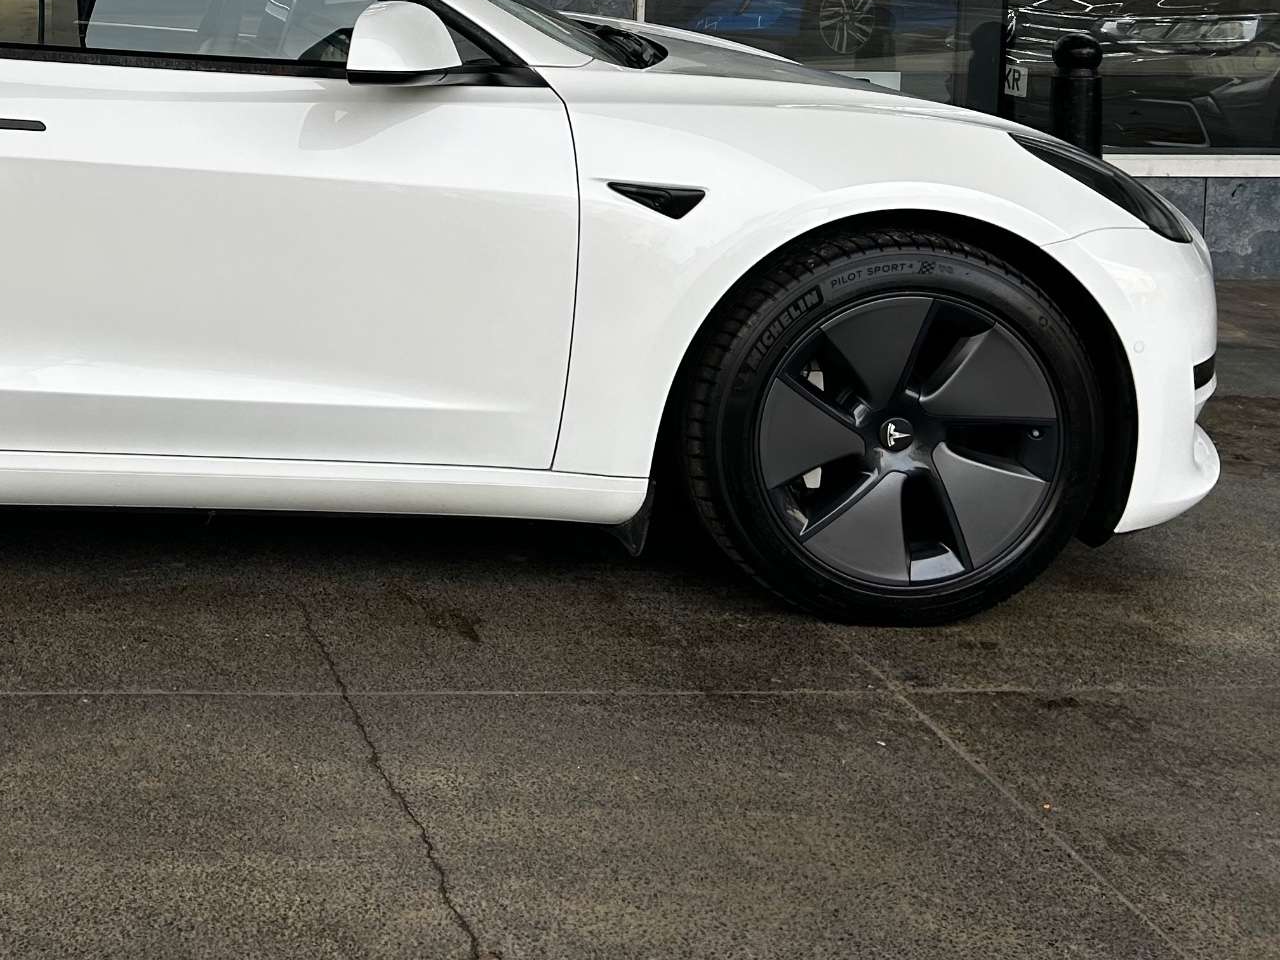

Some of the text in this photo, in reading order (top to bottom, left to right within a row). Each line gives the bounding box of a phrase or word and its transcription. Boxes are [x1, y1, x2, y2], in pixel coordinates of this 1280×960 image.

[746, 289, 821, 370] MICHELIN
[831, 270, 862, 288] PILOT
[867, 263, 905, 276] SPORT
